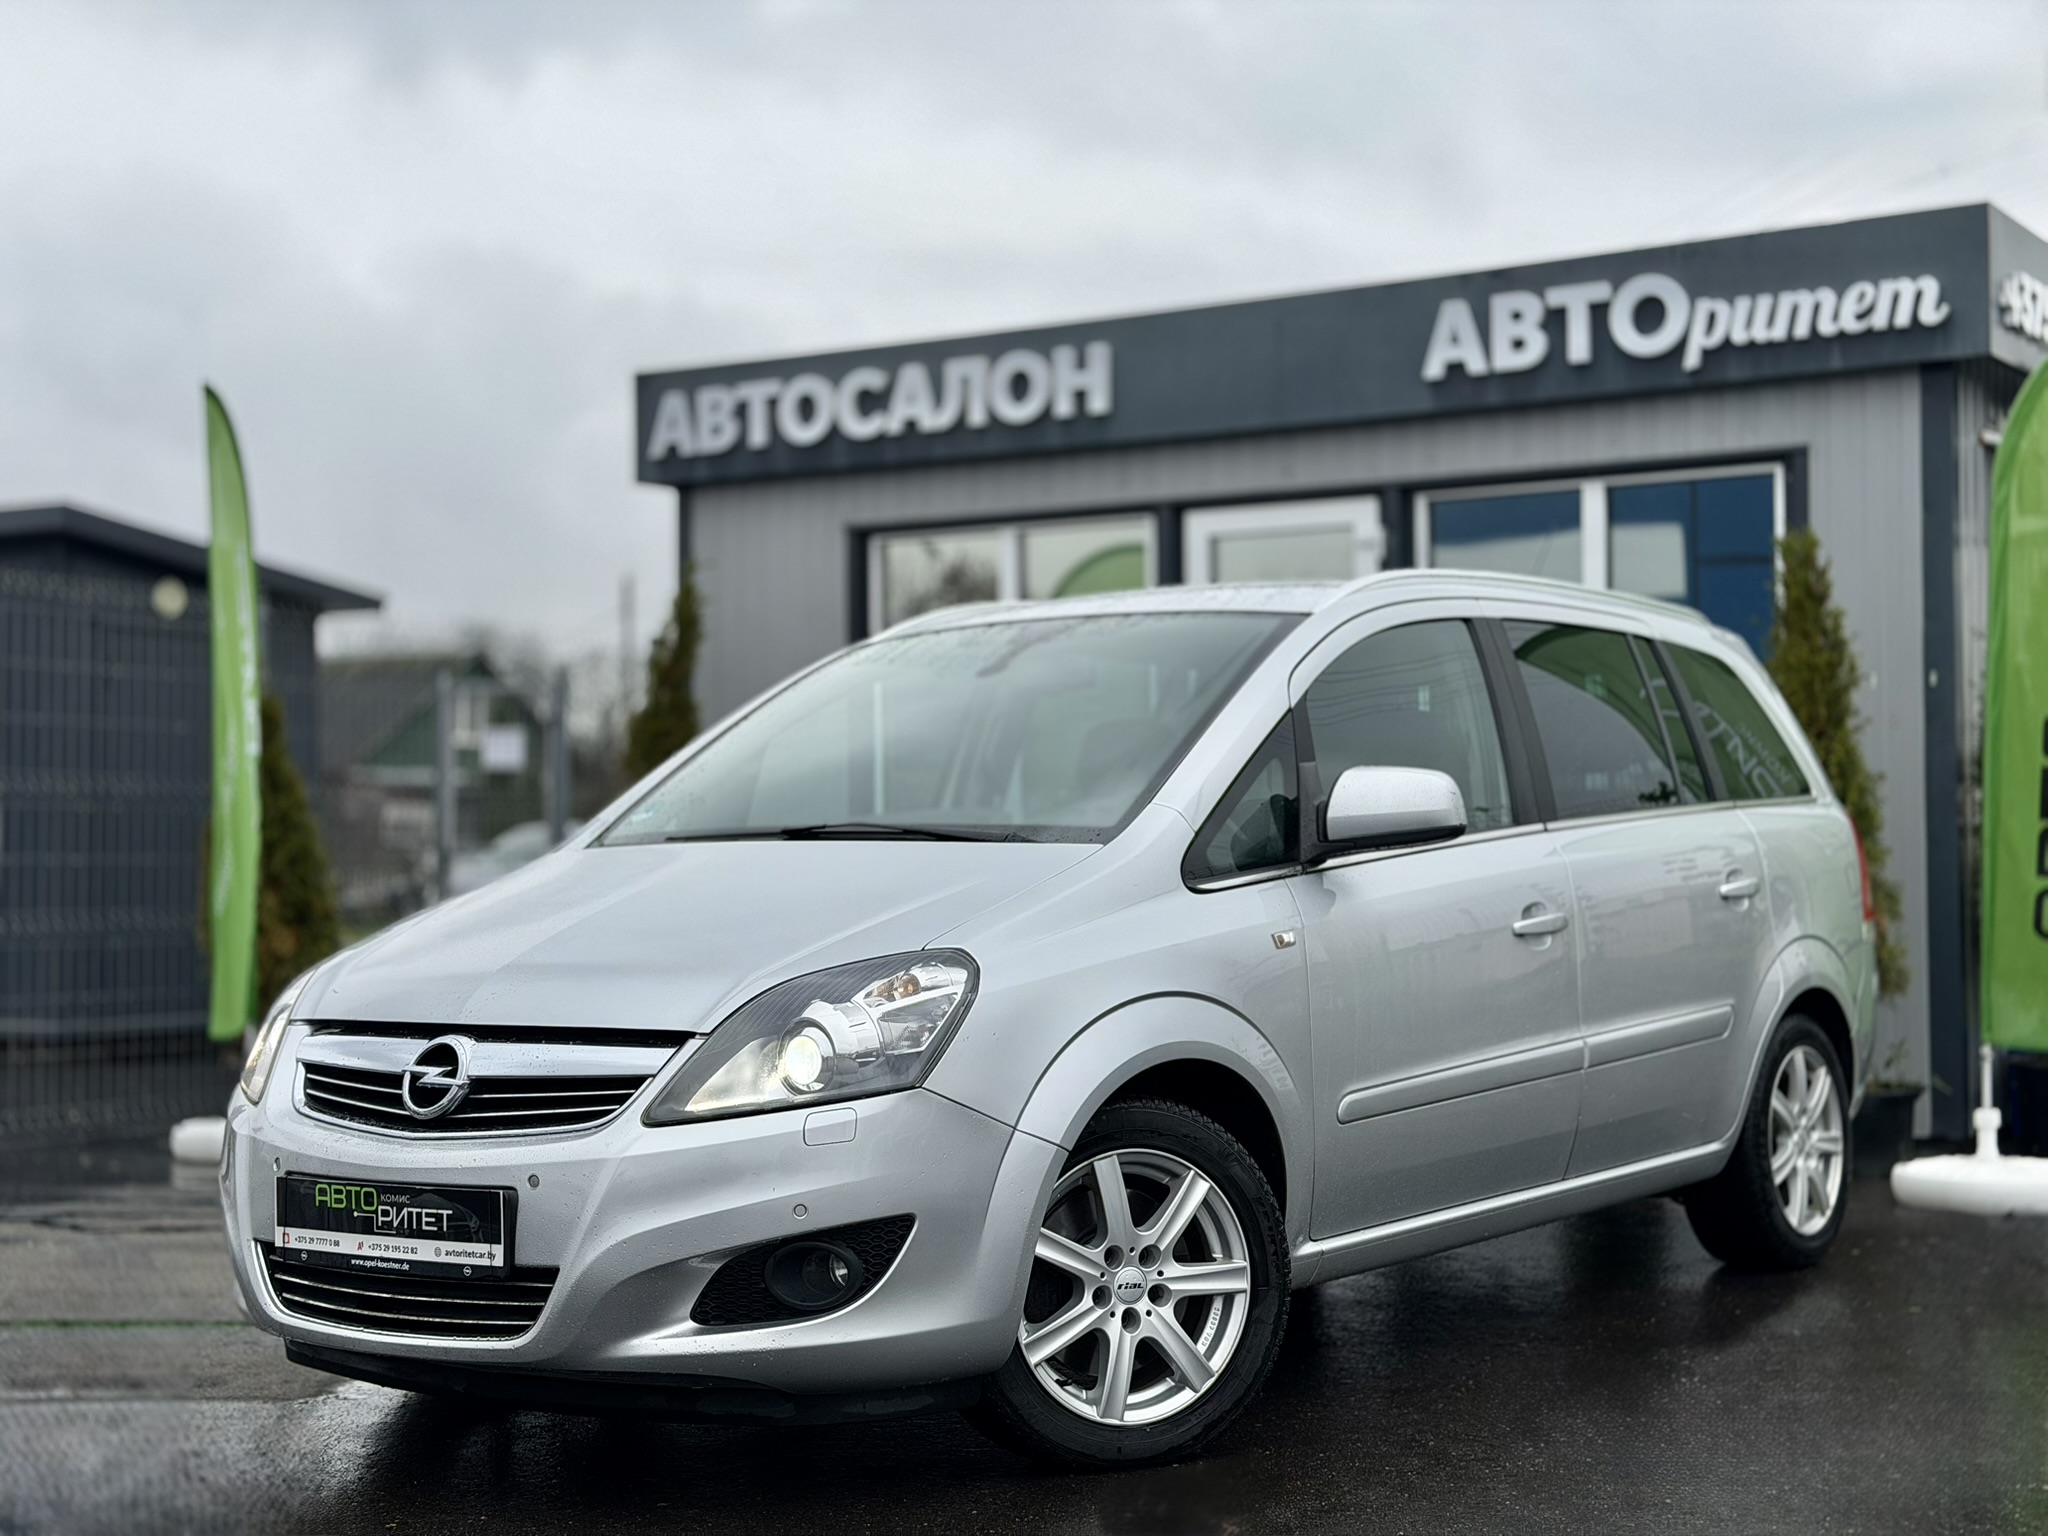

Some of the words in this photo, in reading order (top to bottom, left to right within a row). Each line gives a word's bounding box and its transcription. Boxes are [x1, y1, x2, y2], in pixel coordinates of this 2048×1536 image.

[647, 340, 1112, 461] АВТОСАЛОН
[315, 1184, 377, 1211] АВТО
[380, 1194, 411, 1204] КОМИС
[378, 1205, 453, 1232] РИТЕТ
[294, 1235, 307, 1244] +375
[308, 1237, 315, 1245] 29
[315, 1237, 328, 1246] 7777
[367, 1243, 382, 1252] +375
[383, 1244, 390, 1252] 29
[402, 1246, 409, 1254] 22
[444, 1249, 496, 1261] avtoritetcar.by
[350, 1258, 410, 1271] www.opel-koestner.de
